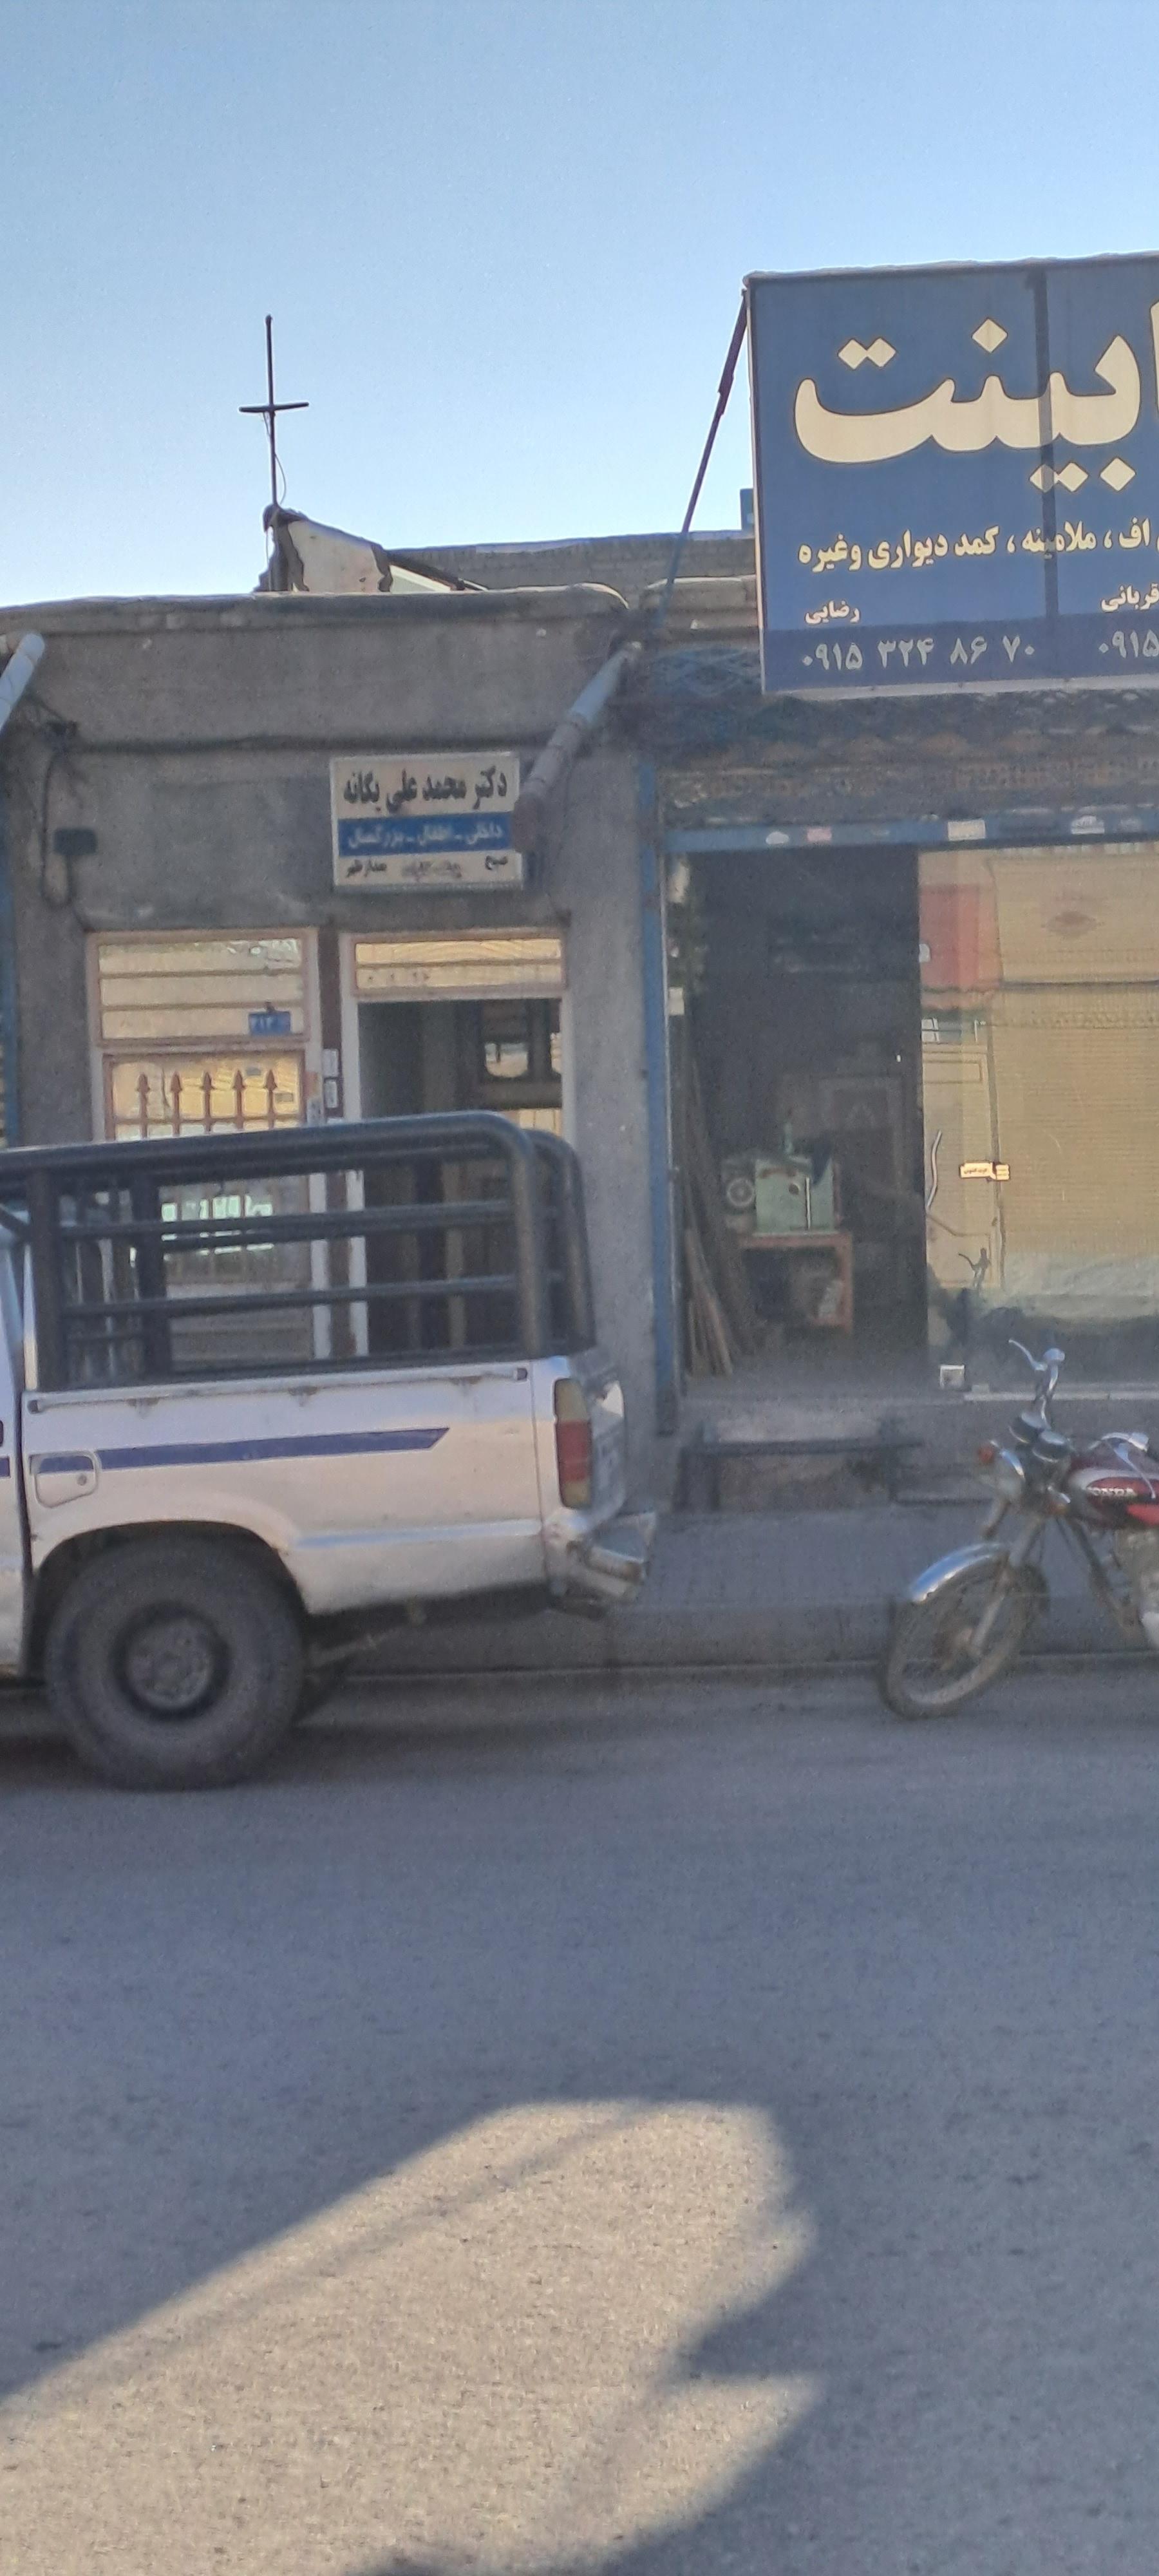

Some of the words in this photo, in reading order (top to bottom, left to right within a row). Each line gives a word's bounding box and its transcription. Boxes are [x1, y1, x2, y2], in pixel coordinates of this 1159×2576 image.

[868, 529, 948, 569] دیواری
[955, 526, 999, 556] کمد
[1022, 520, 1097, 560] ملامینه
[1119, 517, 1151, 548] اف
[805, 600, 860, 625] رضایی
[1100, 583, 1159, 612] قربانی
[344, 772, 381, 813] یگانه
[386, 768, 417, 813] علی
[422, 776, 467, 800] محمد
[473, 764, 507, 810] دکتر
